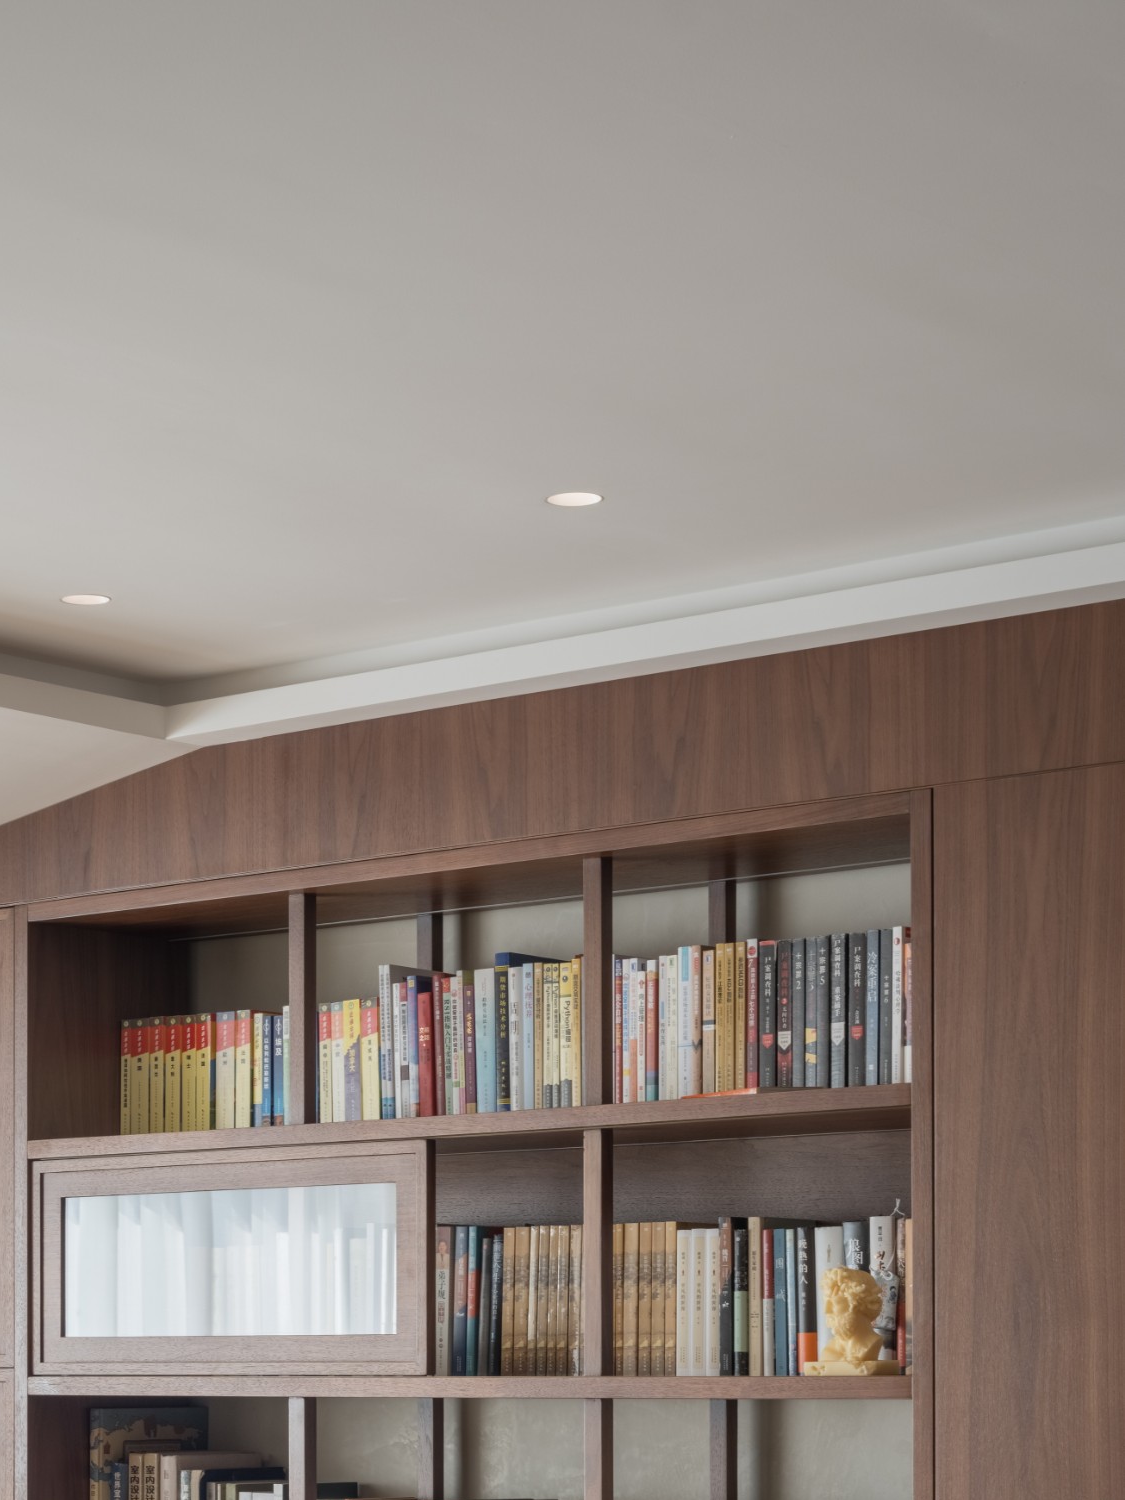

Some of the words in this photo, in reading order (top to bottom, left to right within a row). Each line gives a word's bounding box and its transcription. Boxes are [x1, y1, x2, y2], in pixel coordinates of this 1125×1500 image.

[819, 946, 827, 985] 十宗罪5
[853, 946, 862, 988] 尸案调查科
[867, 950, 878, 1003] 冷案重启
[498, 975, 509, 1041] 期货市场技术分析
[274, 1037, 283, 1058] 埃及
[798, 1239, 809, 1285] 晚熟的人
[847, 1238, 864, 1270] 狼图
